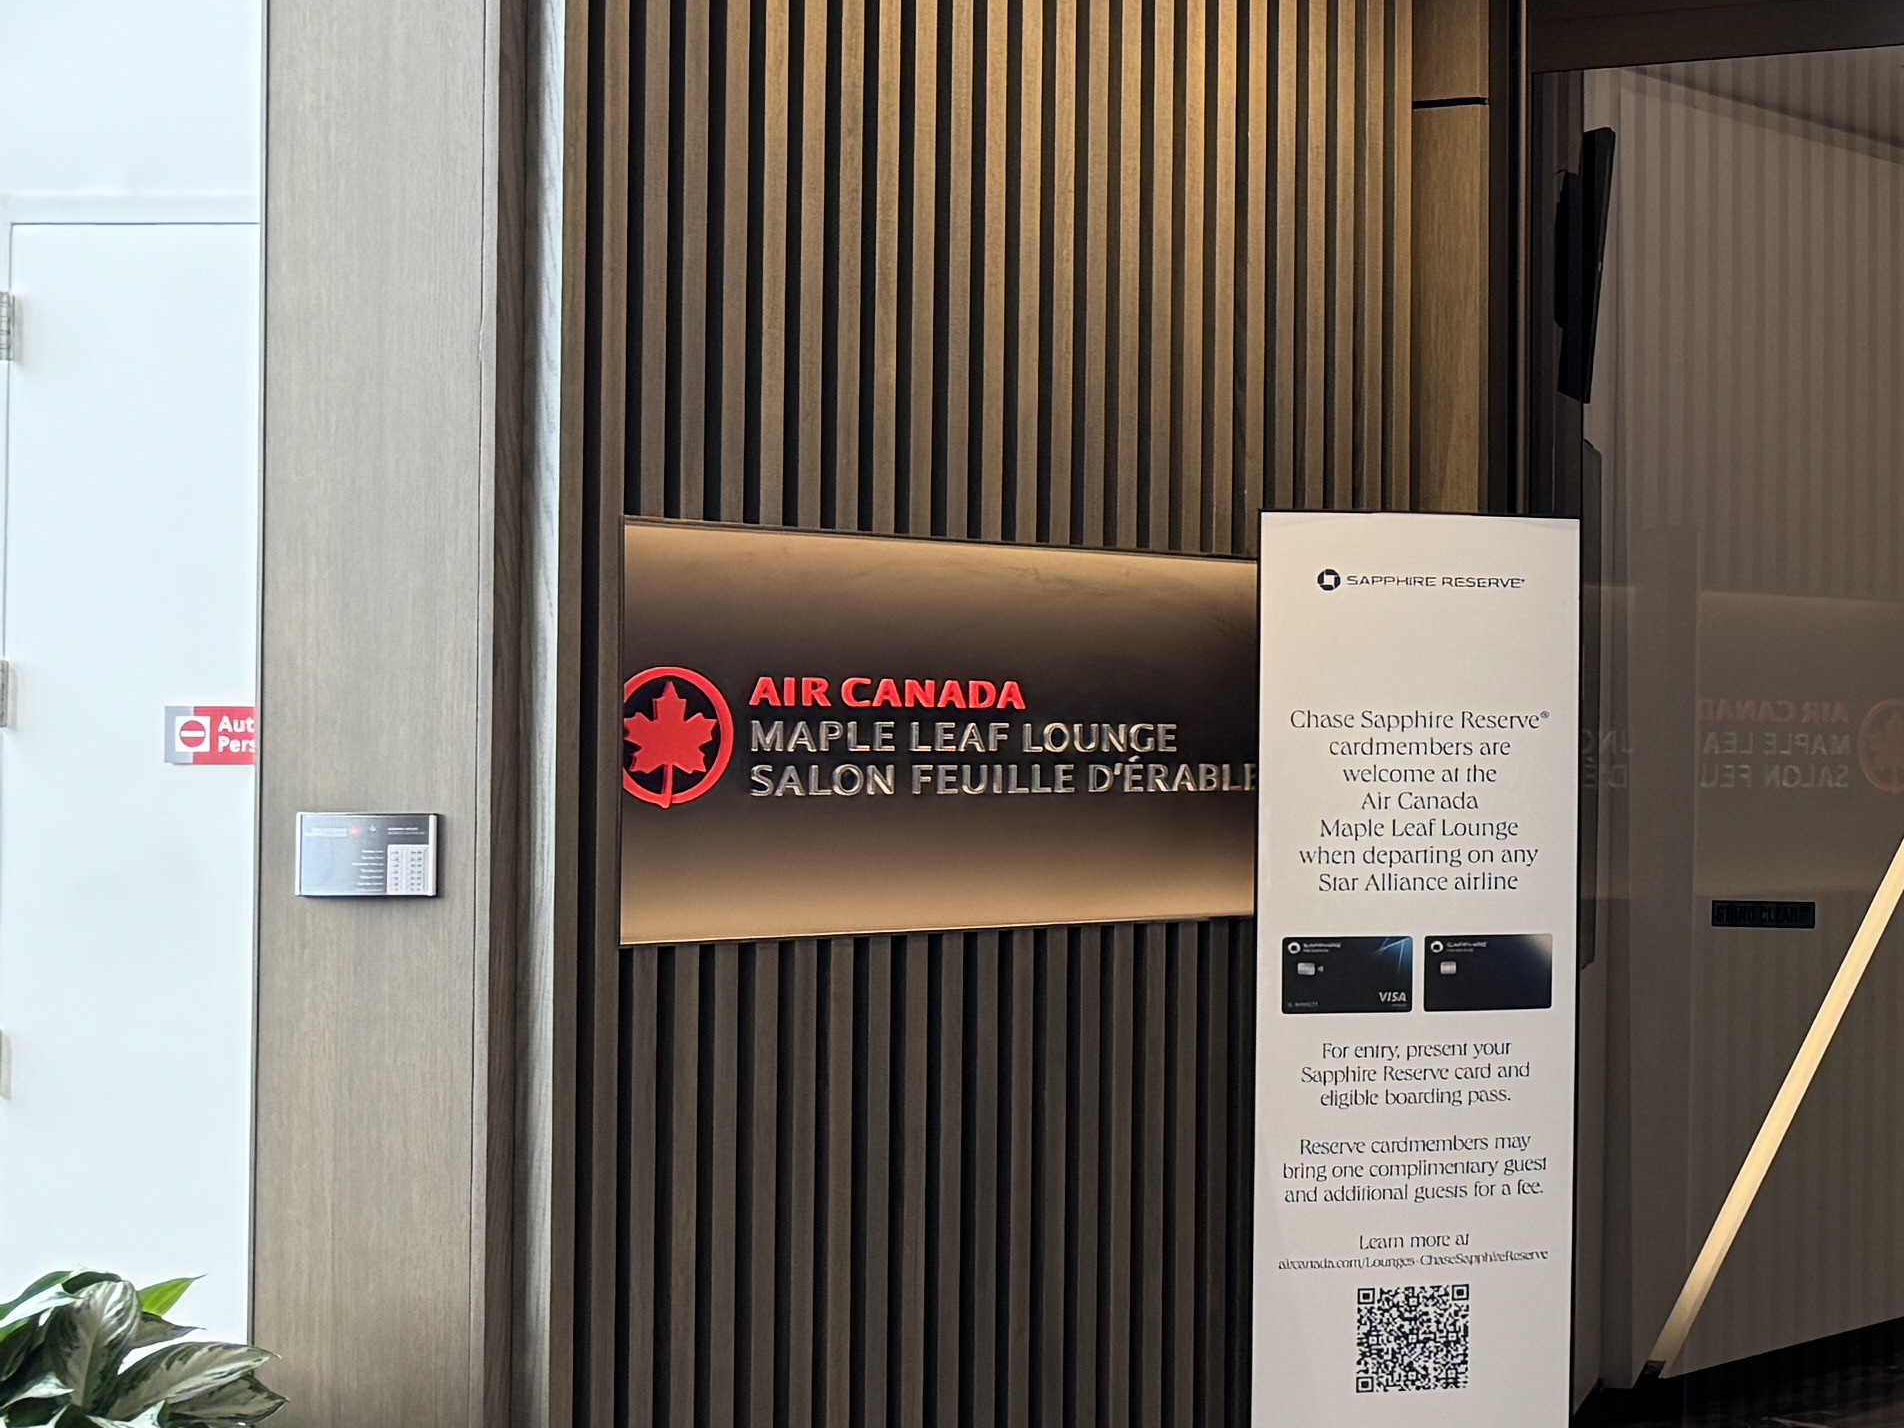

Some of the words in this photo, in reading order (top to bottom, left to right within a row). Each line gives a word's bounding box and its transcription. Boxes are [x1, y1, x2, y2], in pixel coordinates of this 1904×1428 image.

[1347, 576, 1436, 586] SAPPHIRE
[750, 675, 829, 707] AIR
[840, 677, 1026, 710] CANADA
[1291, 710, 1354, 728] Chase
[1361, 710, 1453, 732] Sapphire
[750, 721, 895, 754] MAPLE
[910, 722, 1009, 754] LEAF
[1022, 722, 1177, 754] LOUNGE
[1330, 737, 1473, 755] cardmembers
[1480, 742, 1510, 755] are
[750, 763, 894, 796] SALON
[911, 763, 1075, 795] FEUILLE
[1343, 765, 1435, 782] welcome
[1442, 768, 1458, 782] at
[1467, 764, 1496, 782] the
[1362, 792, 1391, 810] Air
[1398, 791, 1478, 810] Canada
[1321, 819, 1384, 841] Maple
[1393, 818, 1436, 836] Leaf
[1442, 819, 1518, 840] Lounge
[1299, 846, 1355, 864] when
[1363, 846, 1462, 868] departing
[1468, 850, 1493, 863] on
[1502, 849, 1538, 866] any
[1319, 874, 1358, 891] Star
[1365, 873, 1447, 891] Alliance
[1455, 872, 1518, 890] airline
[1716, 905, 1755, 922] STAND
[1379, 992, 1406, 1002] VISA
[1323, 1043, 1349, 1058] For
[1355, 1045, 1399, 1061] entry,
[1407, 1043, 1467, 1060] present
[1473, 1043, 1511, 1059] your
[1302, 1066, 1376, 1086] Sapphire
[1384, 1066, 1449, 1081] Reserve
[1455, 1063, 1490, 1079] card
[1498, 1062, 1529, 1078] and
[1321, 1090, 1378, 1109] eligible
[1386, 1088, 1462, 1106] boarding
[1468, 1089, 1511, 1105] pass.
[1301, 1139, 1365, 1154] Reserve
[1371, 1135, 1488, 1153] cardmembers
[1495, 1136, 1531, 1151] may
[1284, 1163, 1327, 1182] bring
[1332, 1166, 1363, 1178] one
[1369, 1160, 1498, 1179] complimentary
[1504, 1158, 1546, 1176] guest
[1285, 1186, 1317, 1202] and
[1324, 1184, 1407, 1202] additional
[1414, 1185, 1467, 1203] guests
[1475, 1181, 1496, 1196] for
[1502, 1184, 1511, 1195] a
[1518, 1179, 1543, 1194] fee.
[1360, 1235, 1403, 1249] Learn
[1411, 1236, 1450, 1247] more
[1455, 1234, 1469, 1245] at
